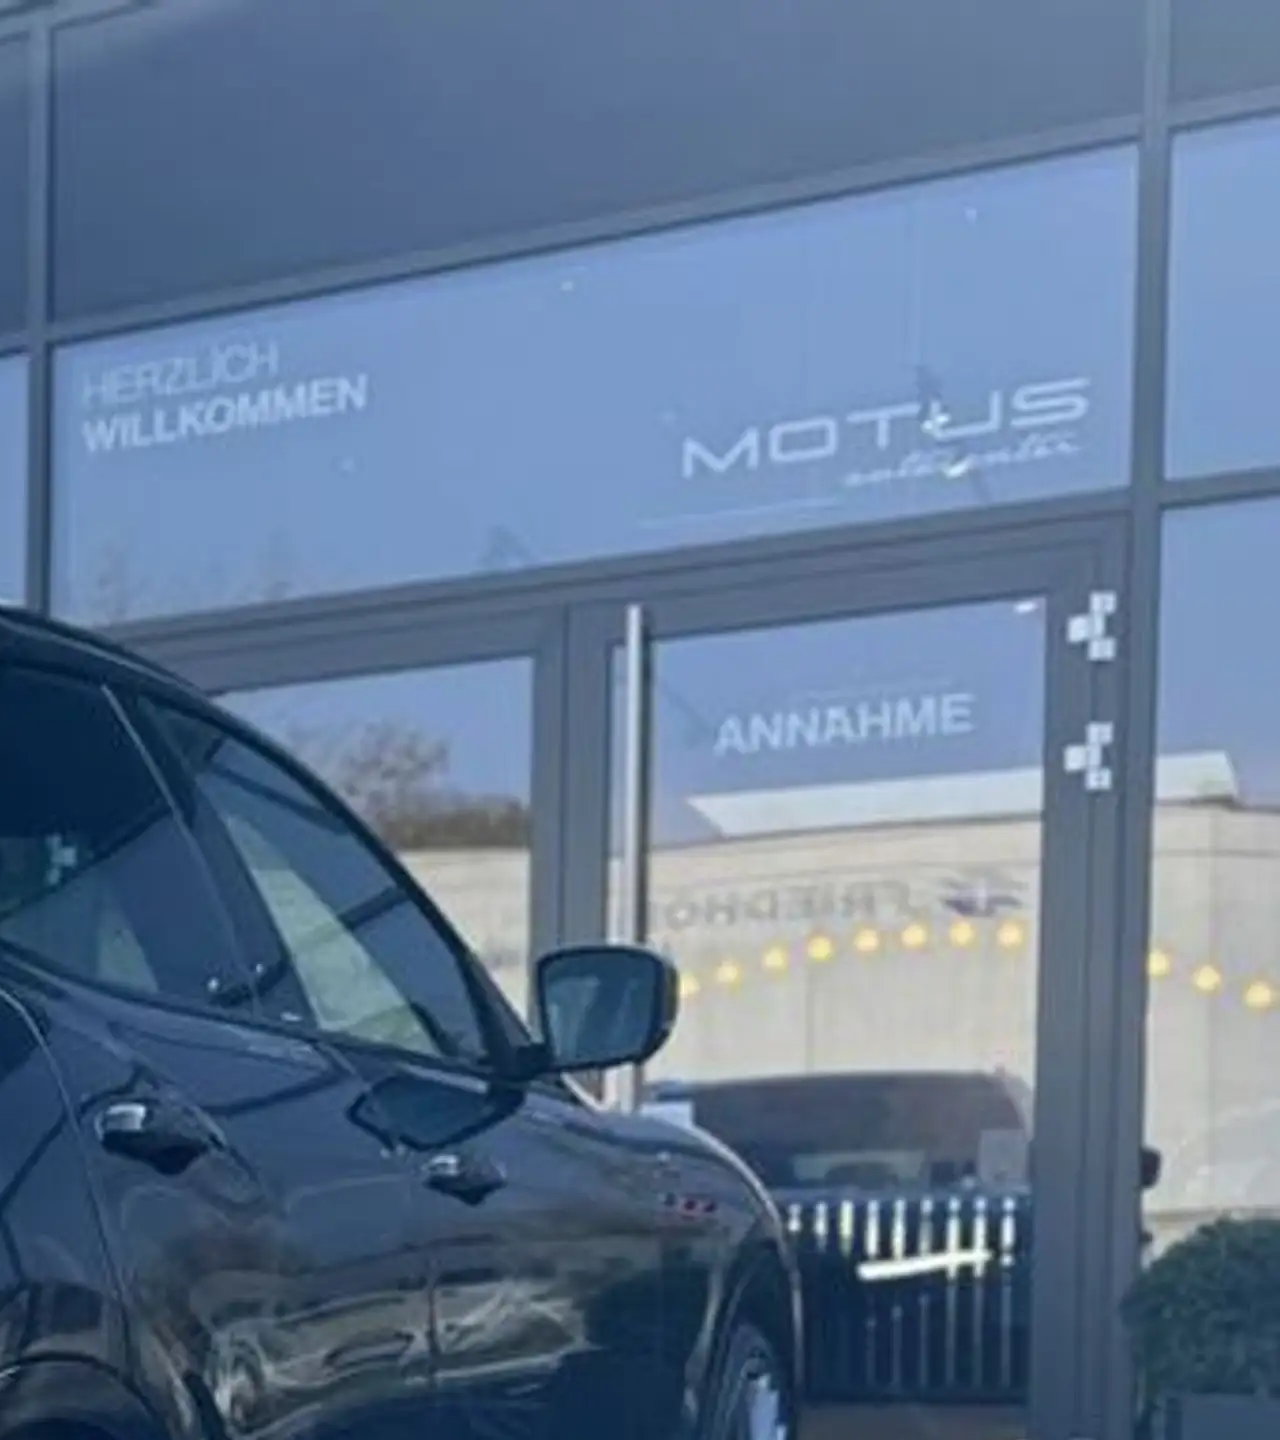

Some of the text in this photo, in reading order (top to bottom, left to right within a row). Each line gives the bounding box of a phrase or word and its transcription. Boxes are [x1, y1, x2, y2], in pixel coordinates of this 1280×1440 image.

[83, 342, 280, 405] HERZLICH
[81, 373, 368, 451] WILLKOMMEN
[682, 377, 1090, 479] MOTUS
[713, 693, 978, 757] ANNAHME
